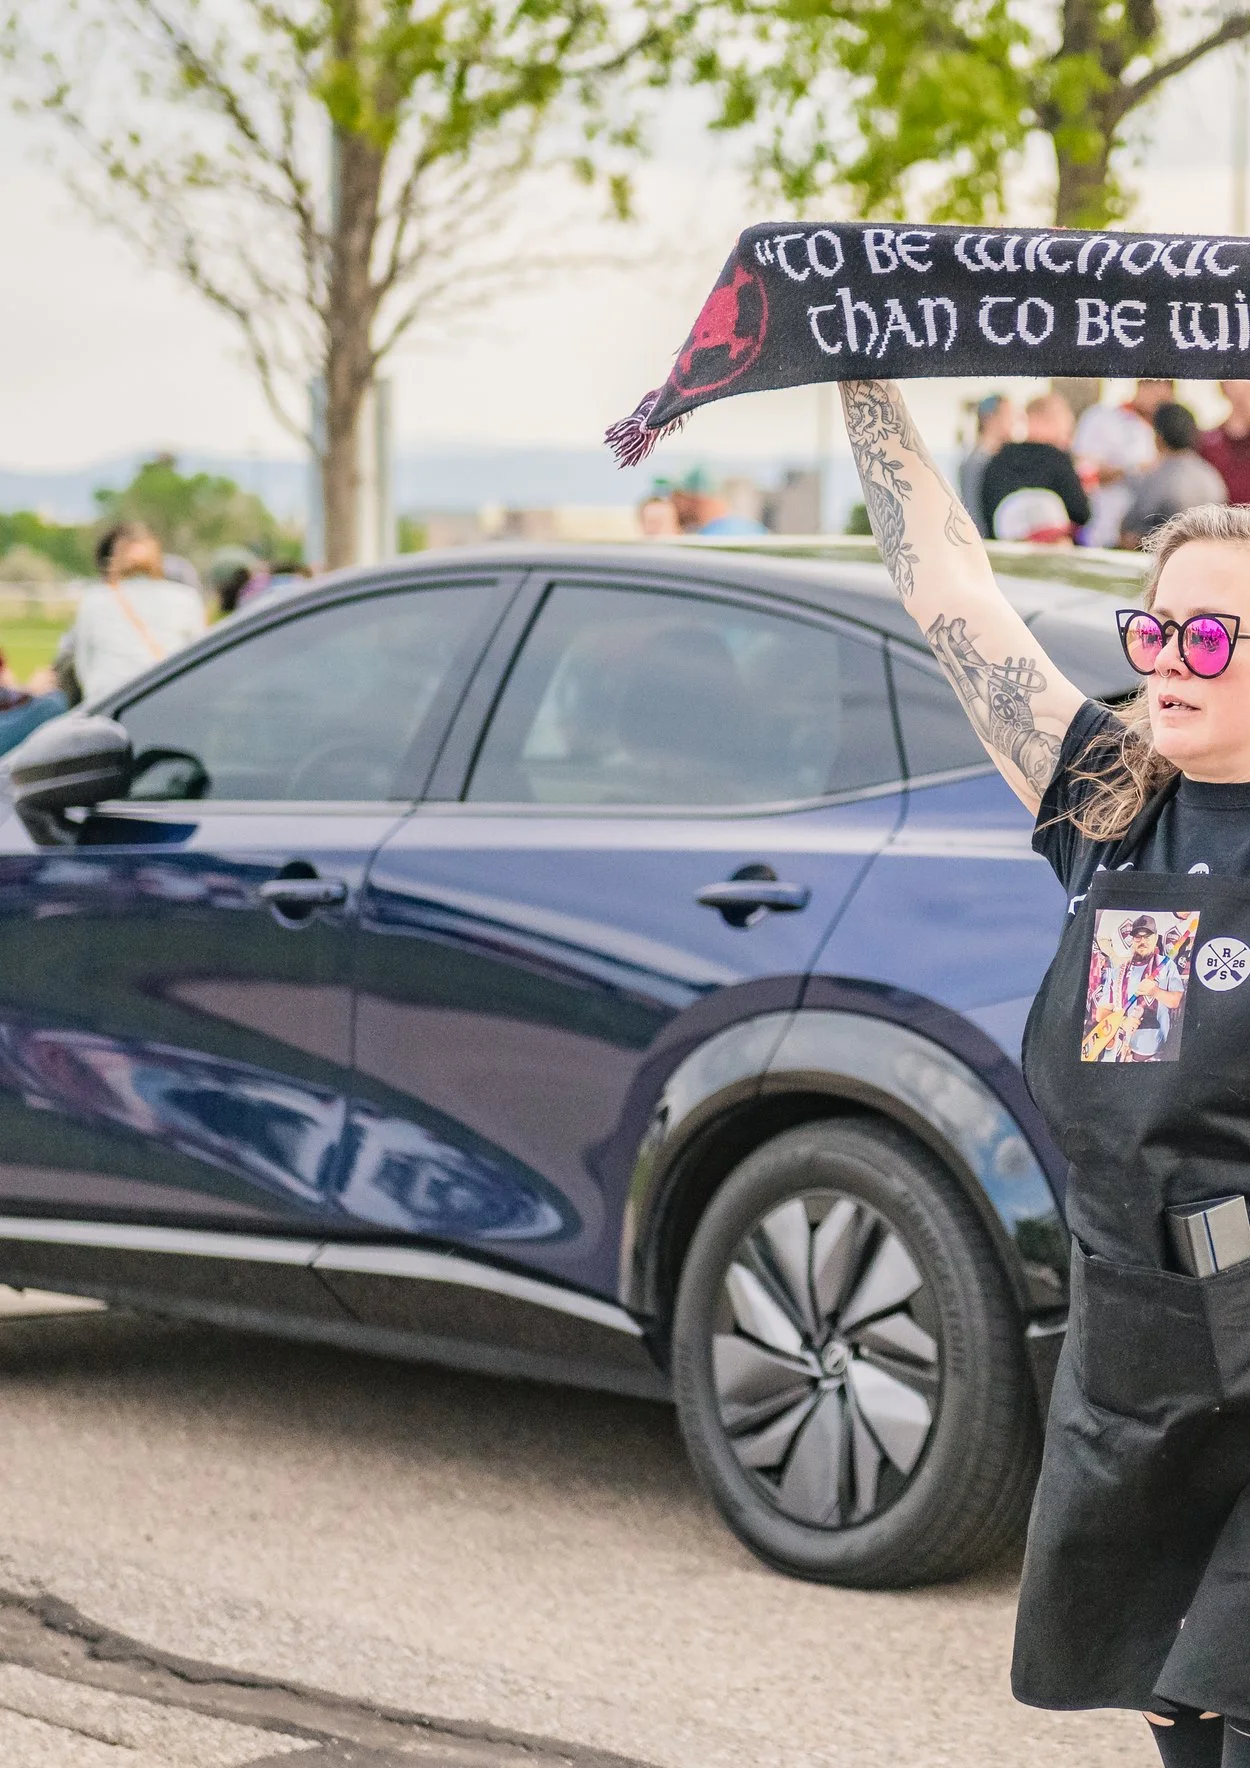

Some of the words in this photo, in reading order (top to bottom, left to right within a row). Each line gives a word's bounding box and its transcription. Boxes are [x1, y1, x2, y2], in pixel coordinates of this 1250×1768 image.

[862, 229, 937, 274] BE
[979, 295, 1055, 345] TO
[1075, 297, 1147, 348] BE
[1222, 947, 1231, 958] R
[1206, 957, 1218, 968] 81
[1232, 959, 1246, 968] 26
[1219, 970, 1228, 980] S
